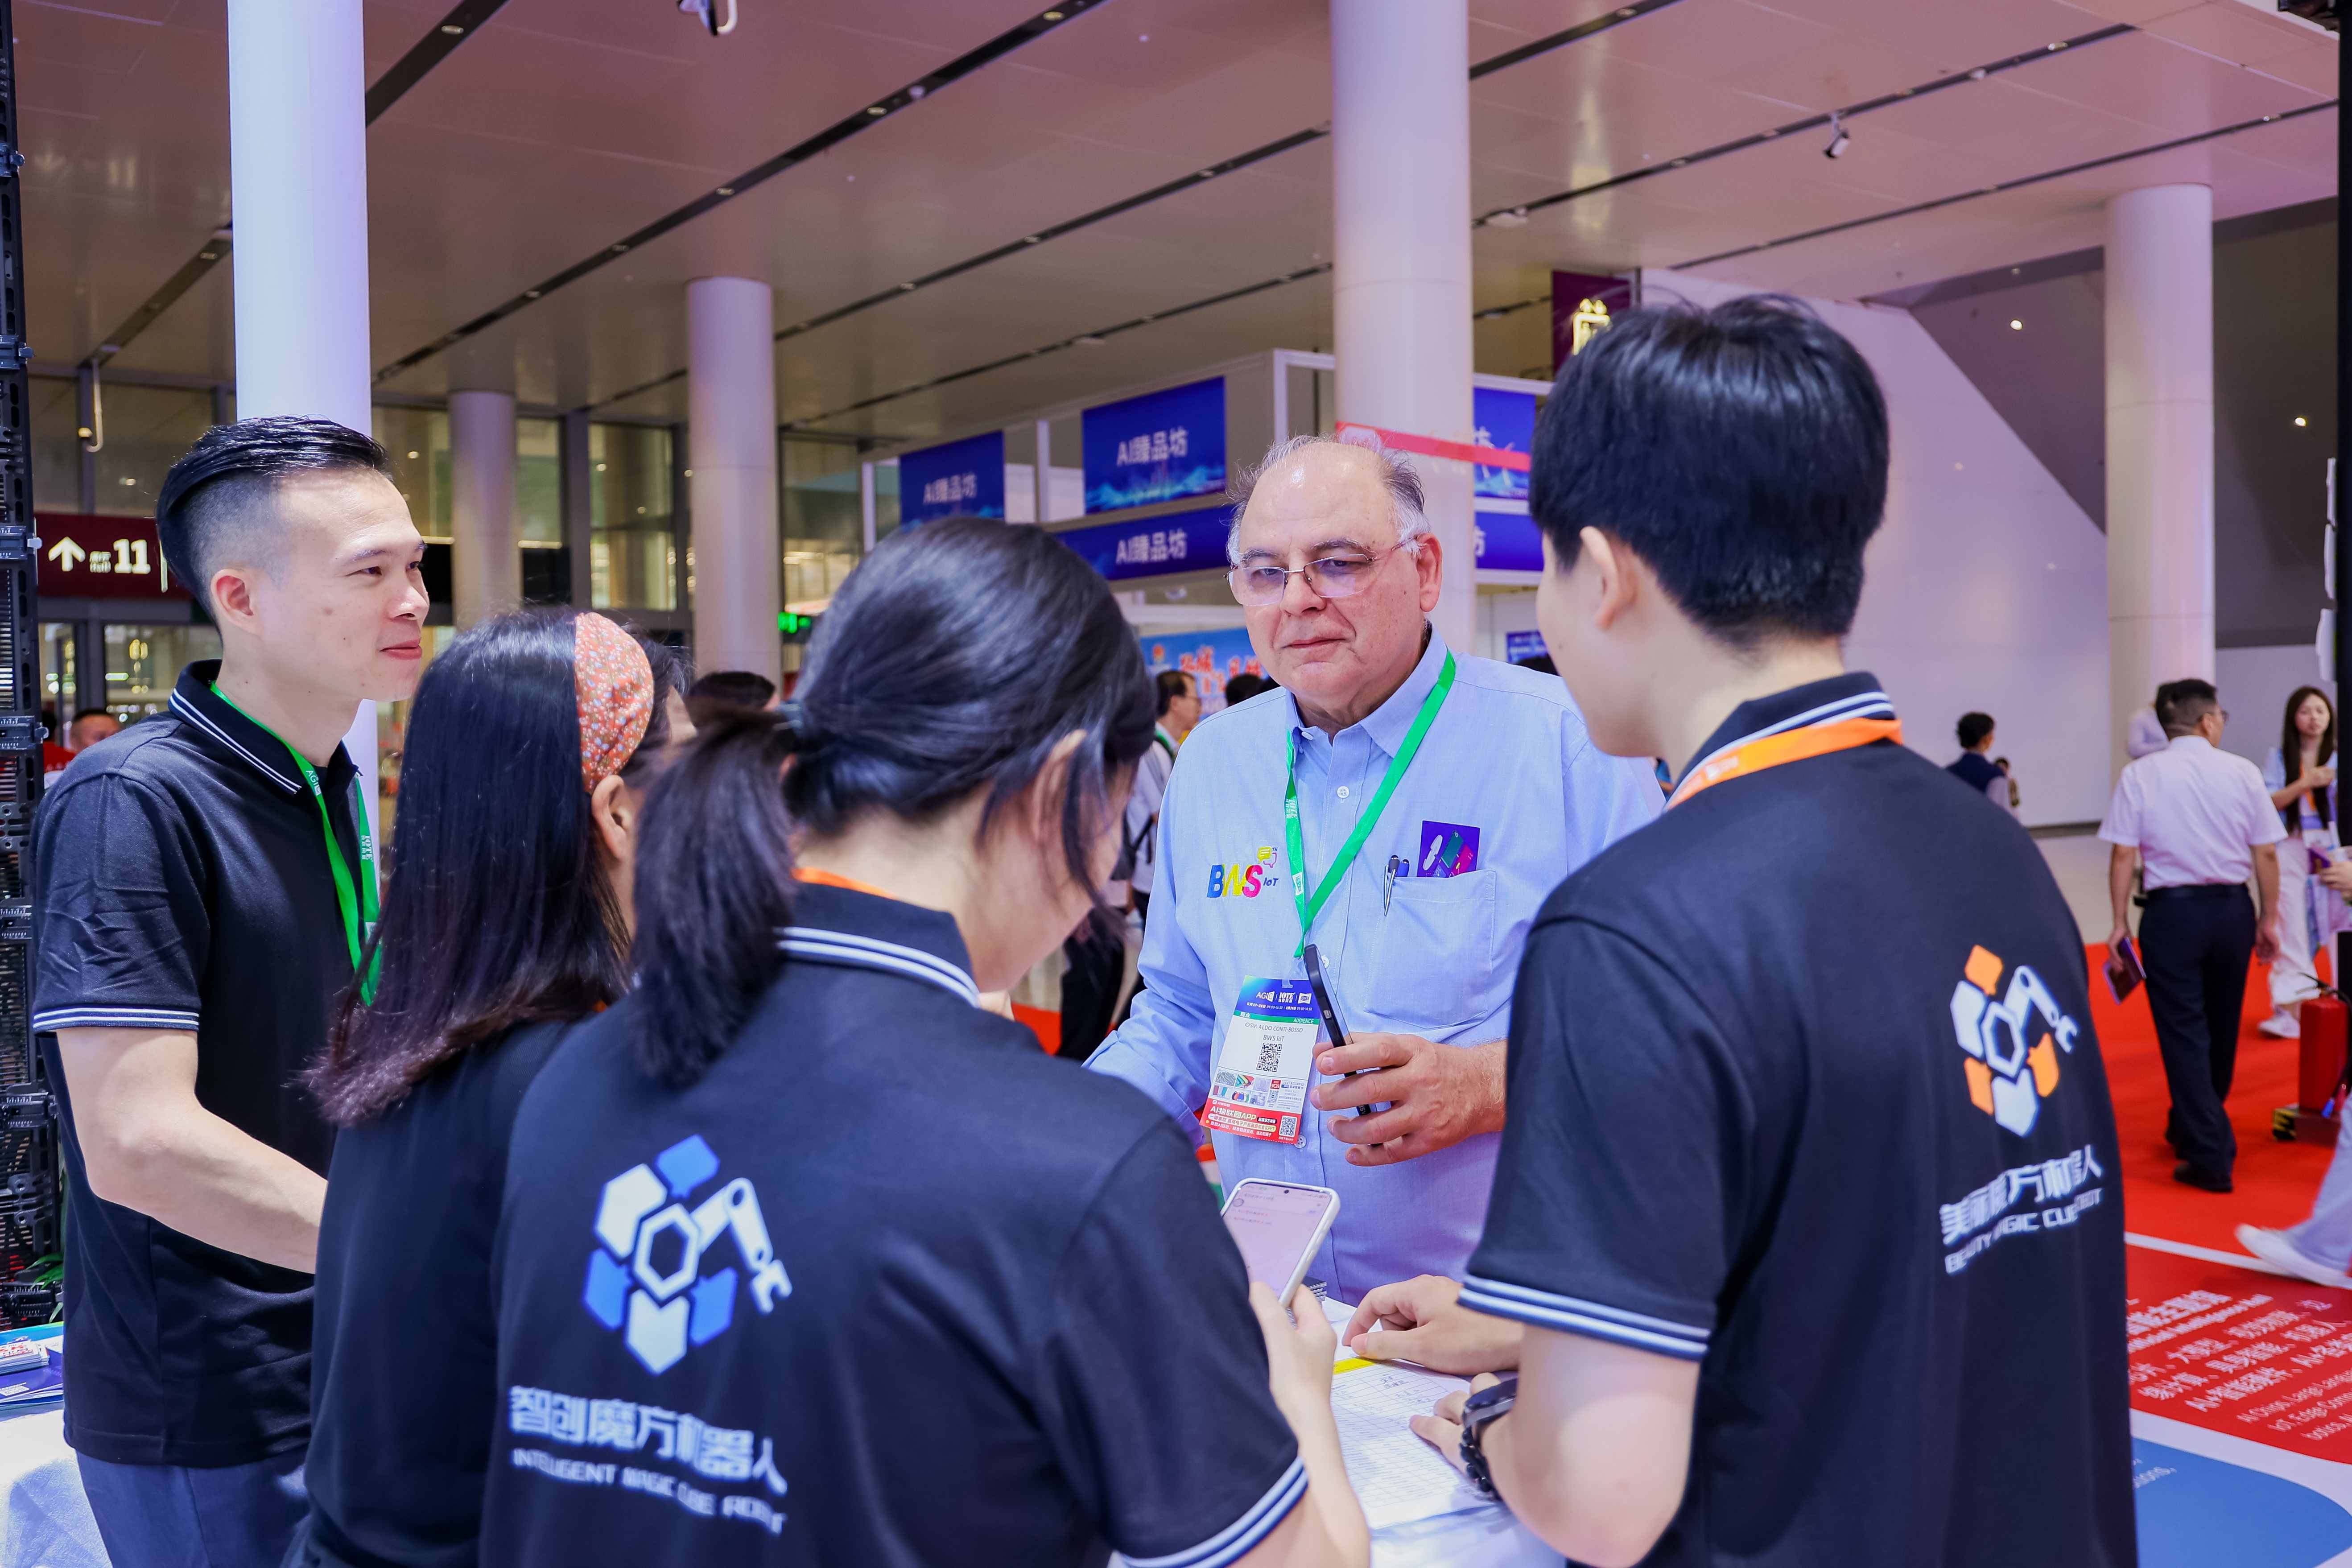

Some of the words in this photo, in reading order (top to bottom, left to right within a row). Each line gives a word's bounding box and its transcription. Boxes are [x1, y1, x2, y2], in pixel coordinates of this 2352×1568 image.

[113, 539, 151, 574] 11
[1263, 877, 1279, 886] IoT
[511, 1385, 788, 1496] 智创魔方机器人
